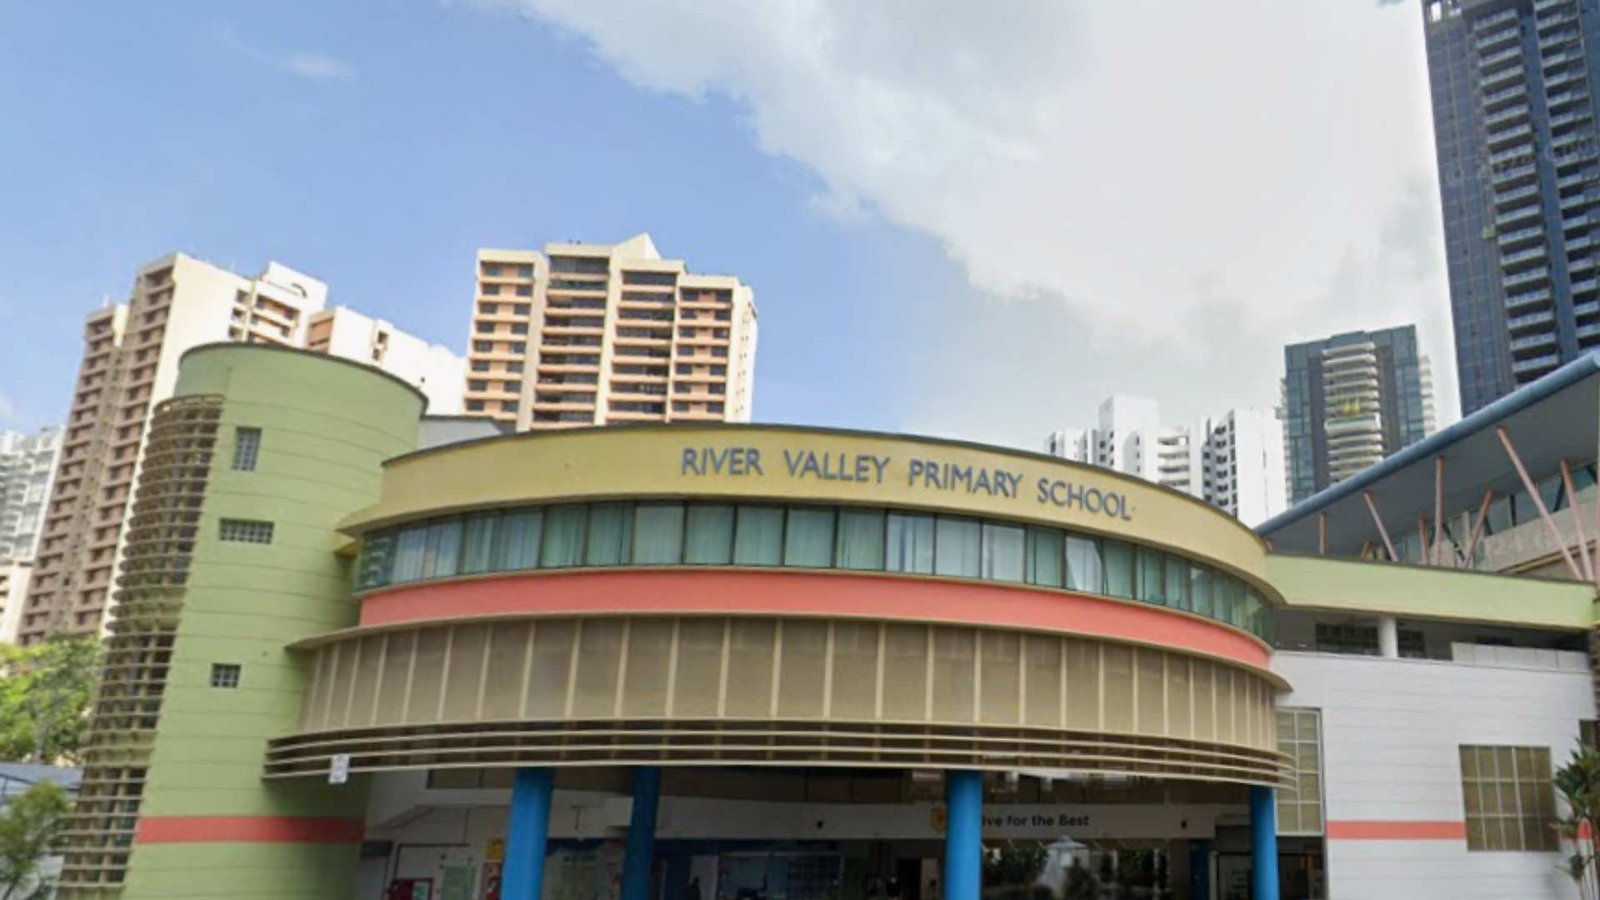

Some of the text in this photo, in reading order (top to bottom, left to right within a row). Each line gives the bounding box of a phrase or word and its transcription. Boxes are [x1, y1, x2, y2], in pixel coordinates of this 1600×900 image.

[681, 447, 1132, 521] RIVER VALLEY PRIMARY SCHOOL
[1007, 814, 1028, 826] for
[1031, 814, 1054, 826] the
[1059, 814, 1090, 826] Best
